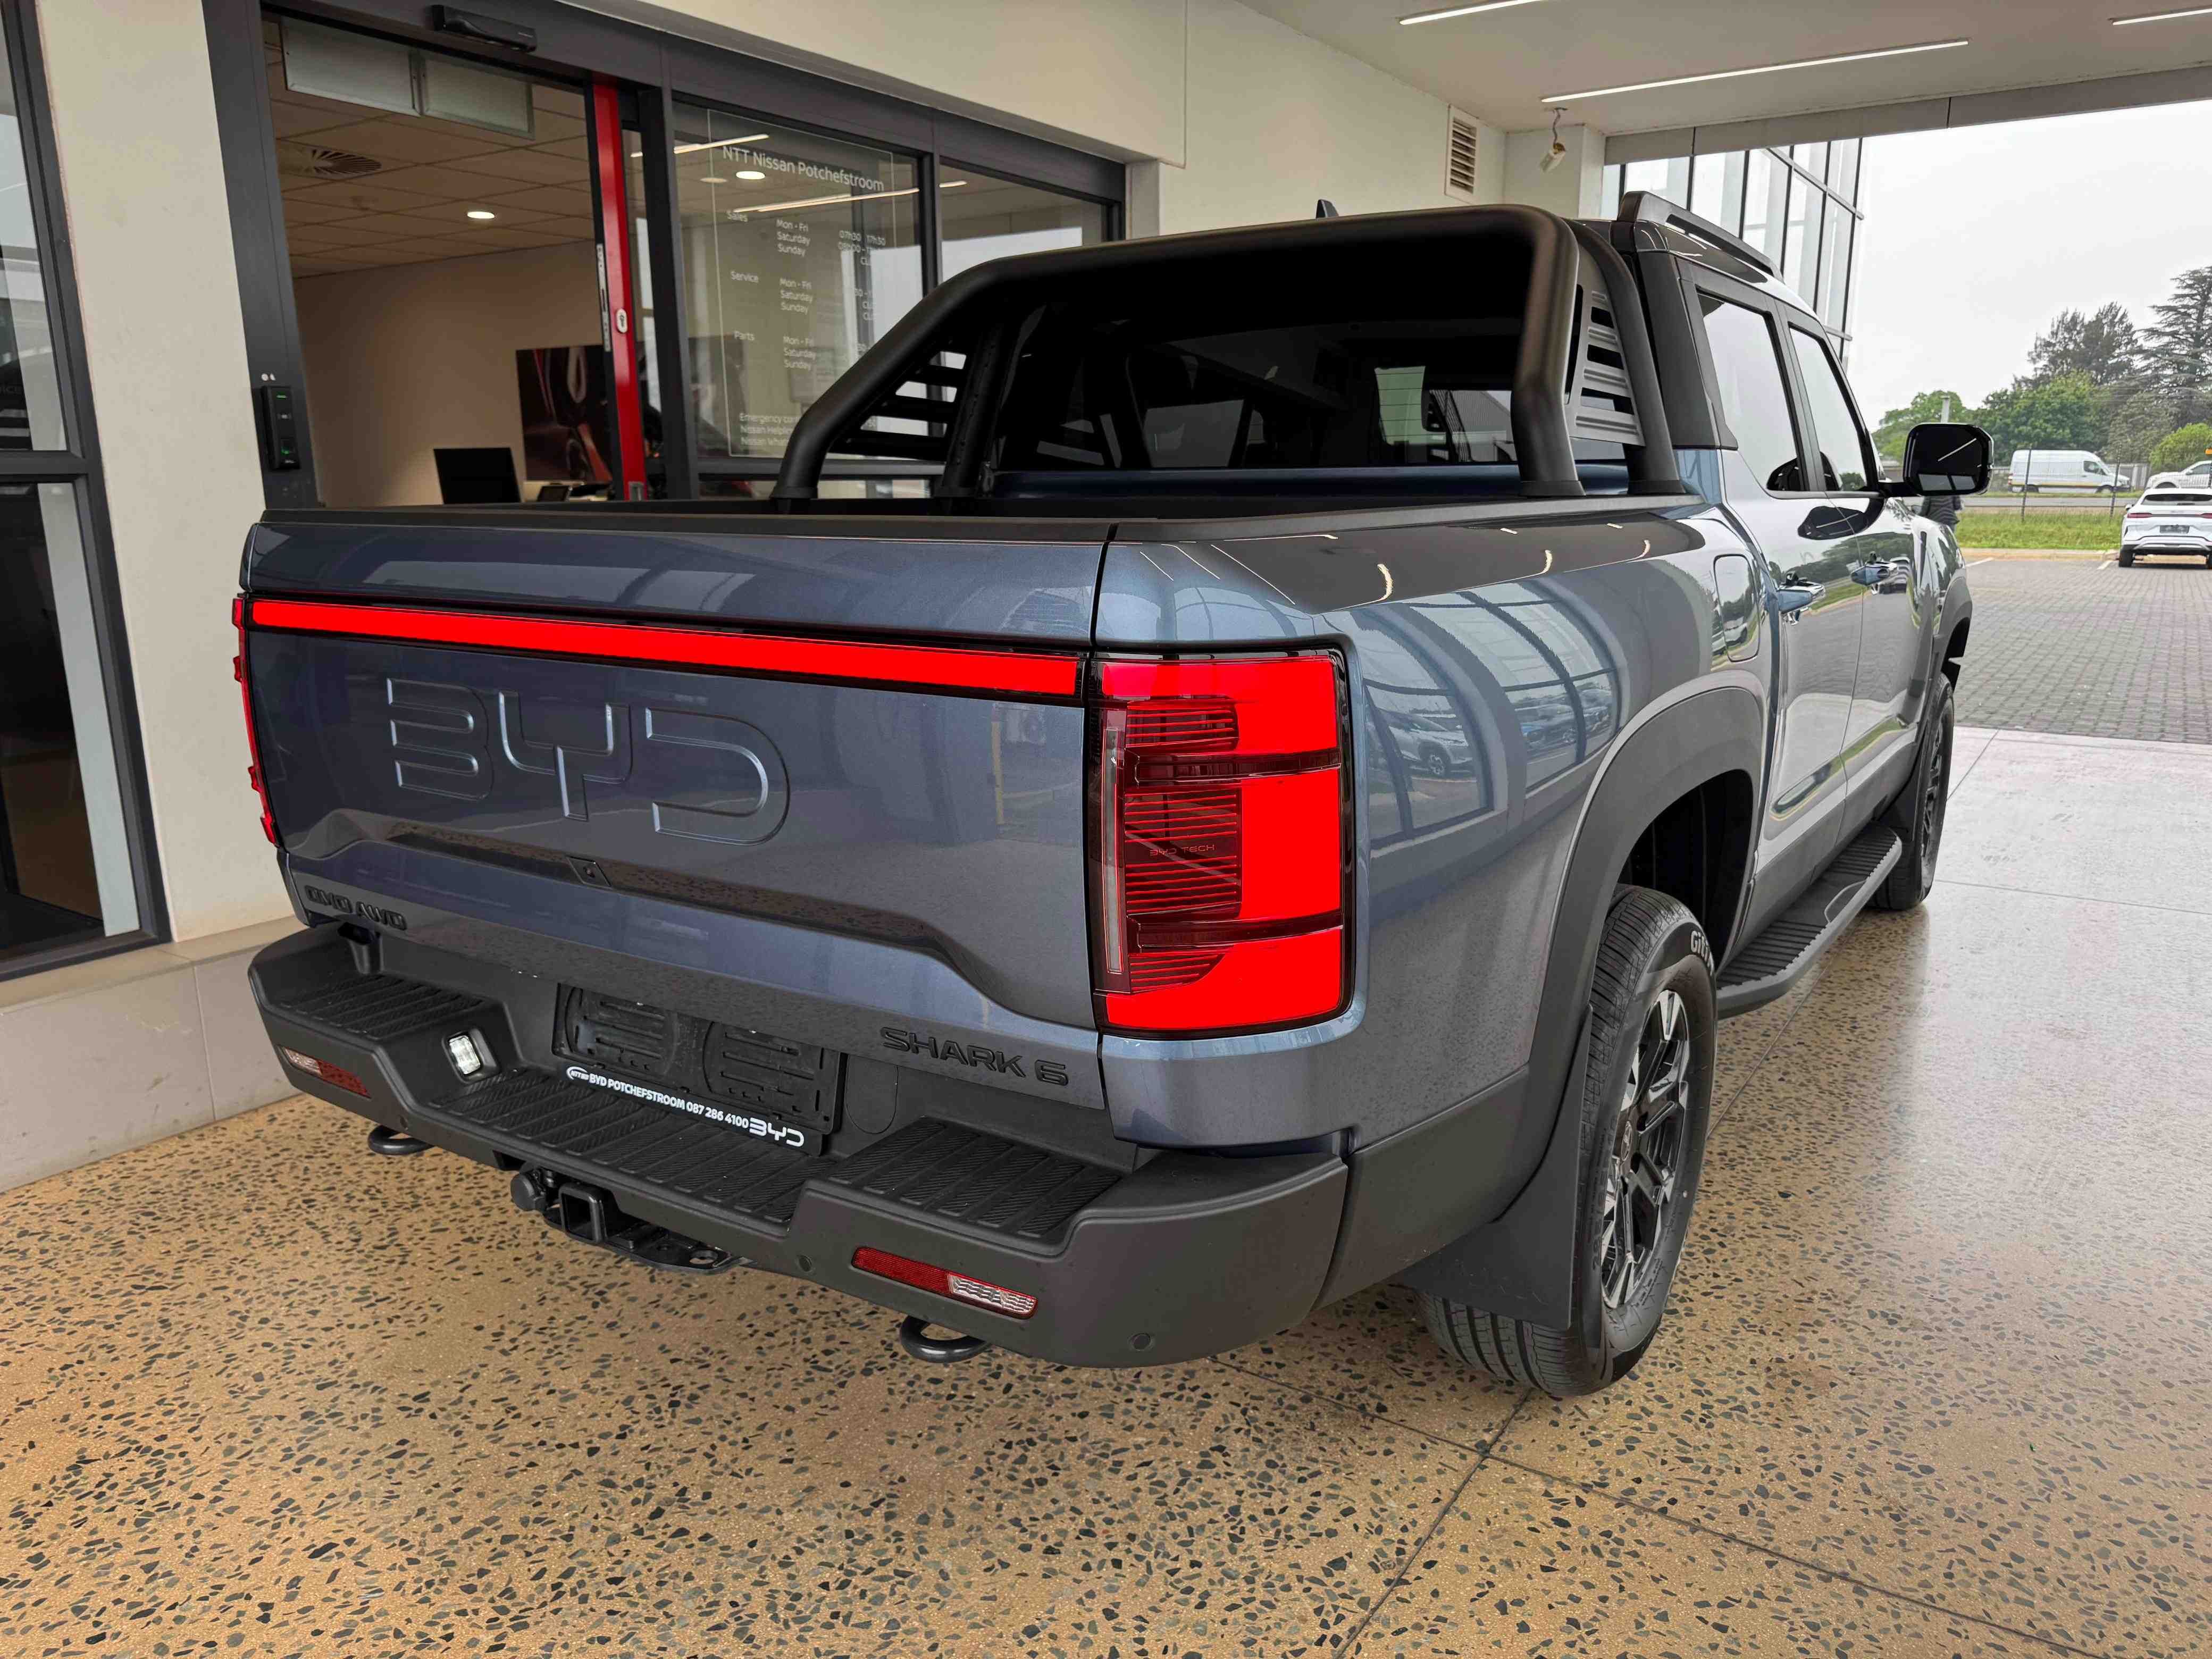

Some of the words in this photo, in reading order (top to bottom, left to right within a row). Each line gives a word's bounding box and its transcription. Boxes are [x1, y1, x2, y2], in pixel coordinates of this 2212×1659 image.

[723, 146, 750, 164] NTT
[753, 152, 795, 174] Nissan
[798, 162, 884, 191] Potchefstroom
[727, 211, 748, 222] Sales
[776, 219, 793, 229] Mon
[777, 231, 811, 246] Saturday
[777, 244, 806, 257] Sunday
[731, 271, 759, 283] Service
[780, 278, 797, 288] Mon
[780, 301, 808, 315] Sunday
[734, 331, 755, 341] Parts
[386, 677, 791, 847] BYD
[1183, 844, 1214, 853] TECH
[355, 901, 407, 931] AWD
[880, 1026, 1026, 1078] SHARK
[1034, 1059, 1069, 1086] 6
[589, 1073, 607, 1086] BYD
[607, 1078, 685, 1110] POTCHEFSTROOM
[686, 1101, 705, 1115] 087
[705, 1107, 724, 1121] 286
[724, 1112, 749, 1129] 4100
[749, 1117, 804, 1147] BYD
